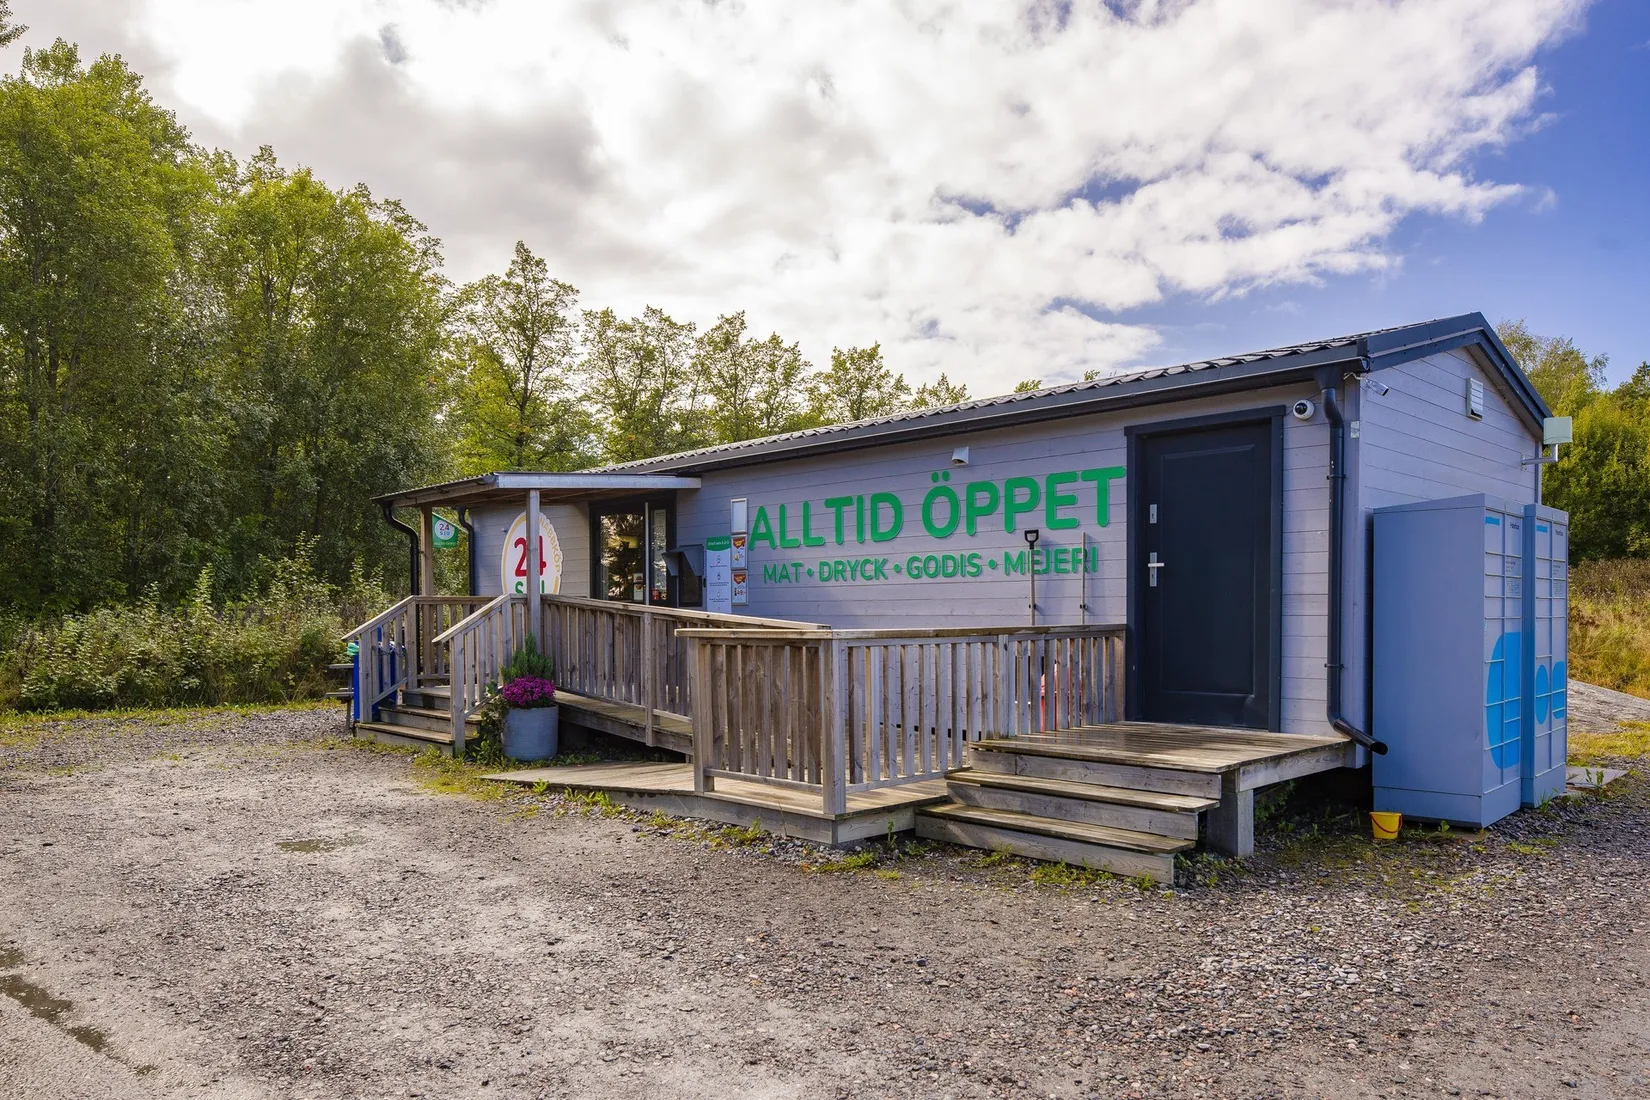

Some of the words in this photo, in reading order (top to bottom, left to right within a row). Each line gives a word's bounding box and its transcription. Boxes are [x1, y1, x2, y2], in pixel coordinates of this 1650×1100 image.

[749, 491, 904, 551] ALLTID
[922, 466, 1127, 539] ÖPPET
[538, 515, 562, 574] NABBKÖP
[763, 562, 804, 584] MAT
[818, 557, 889, 582] DRYCK
[906, 552, 982, 579] GODIS
[1003, 546, 1099, 576] MEJERI
